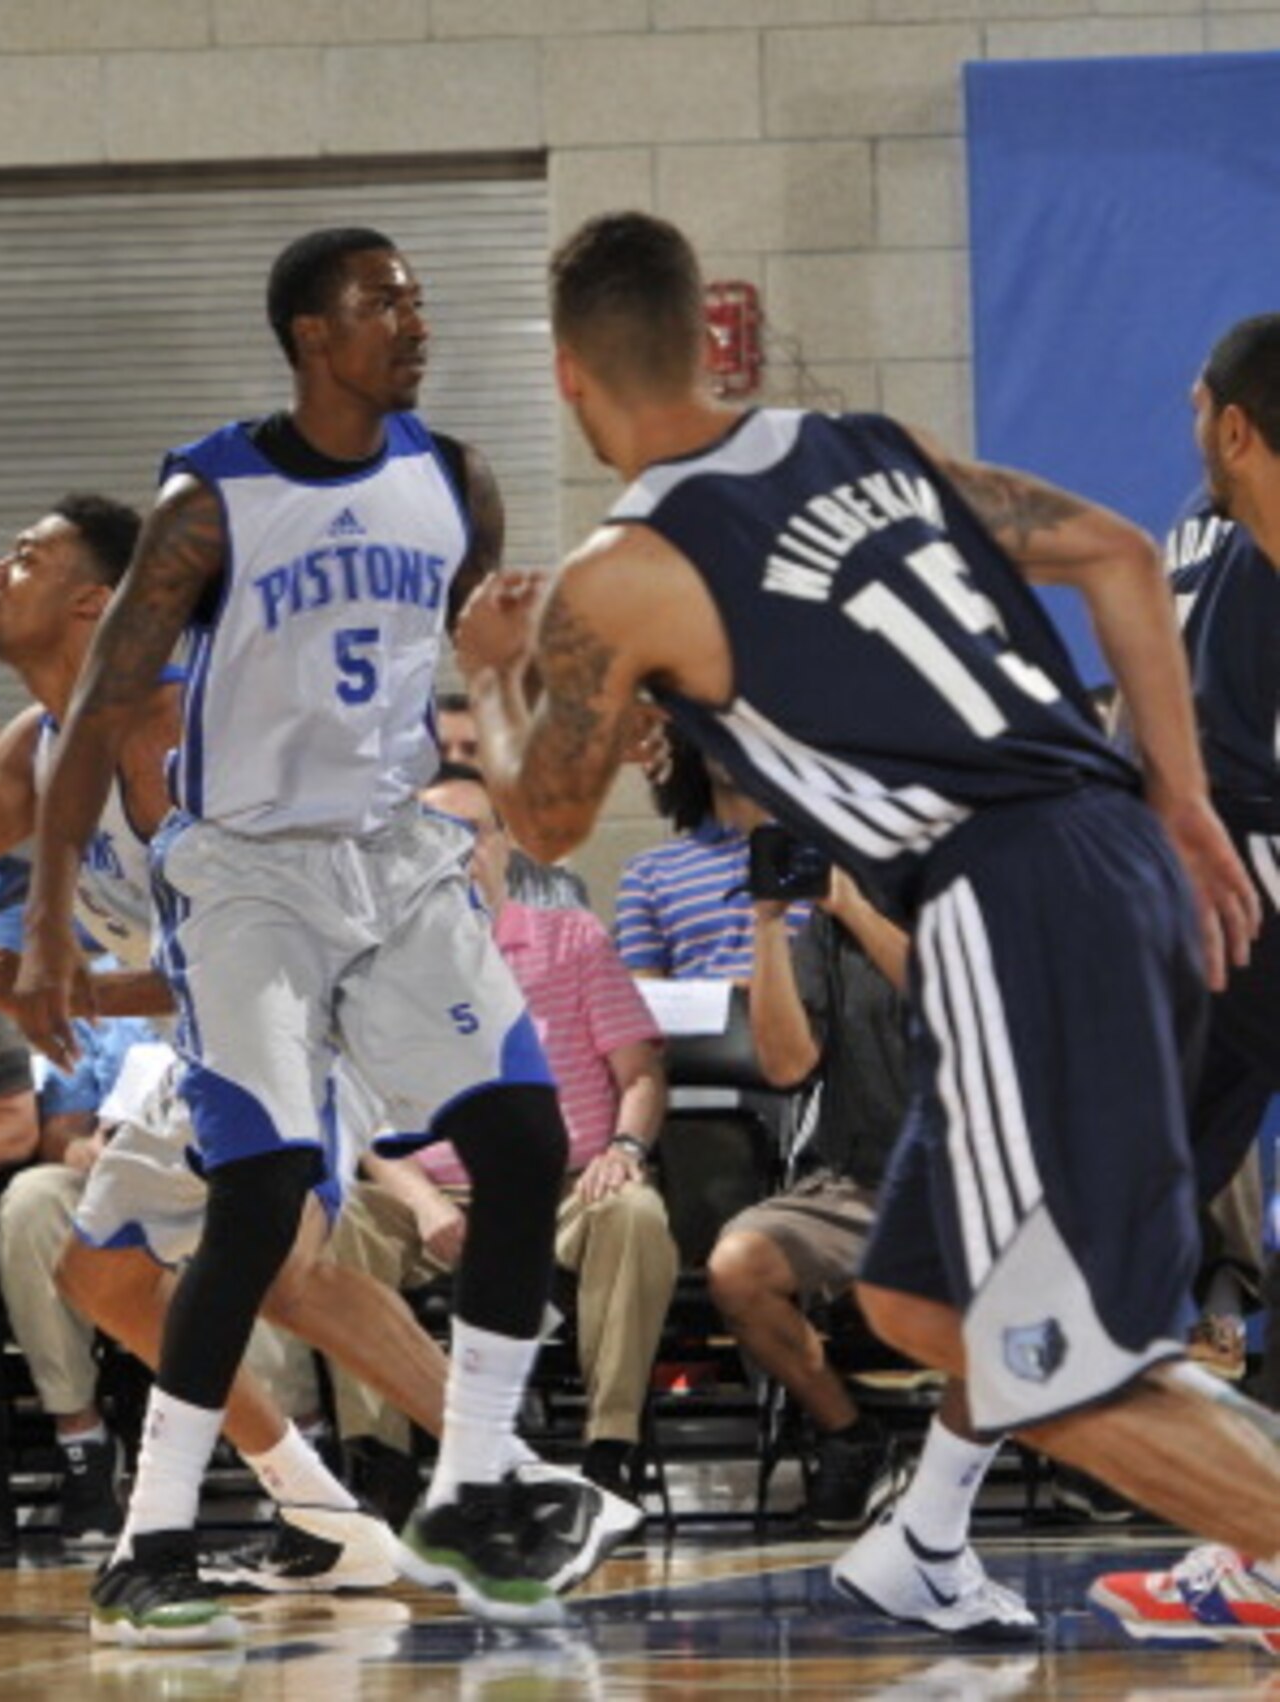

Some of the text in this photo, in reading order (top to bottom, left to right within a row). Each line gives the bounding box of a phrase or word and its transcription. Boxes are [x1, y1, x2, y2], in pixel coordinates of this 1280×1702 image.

[254, 545, 446, 632] PISTONS
[335, 628, 380, 706] 5
[841, 541, 1061, 739] 15
[449, 1003, 479, 1034] 5
